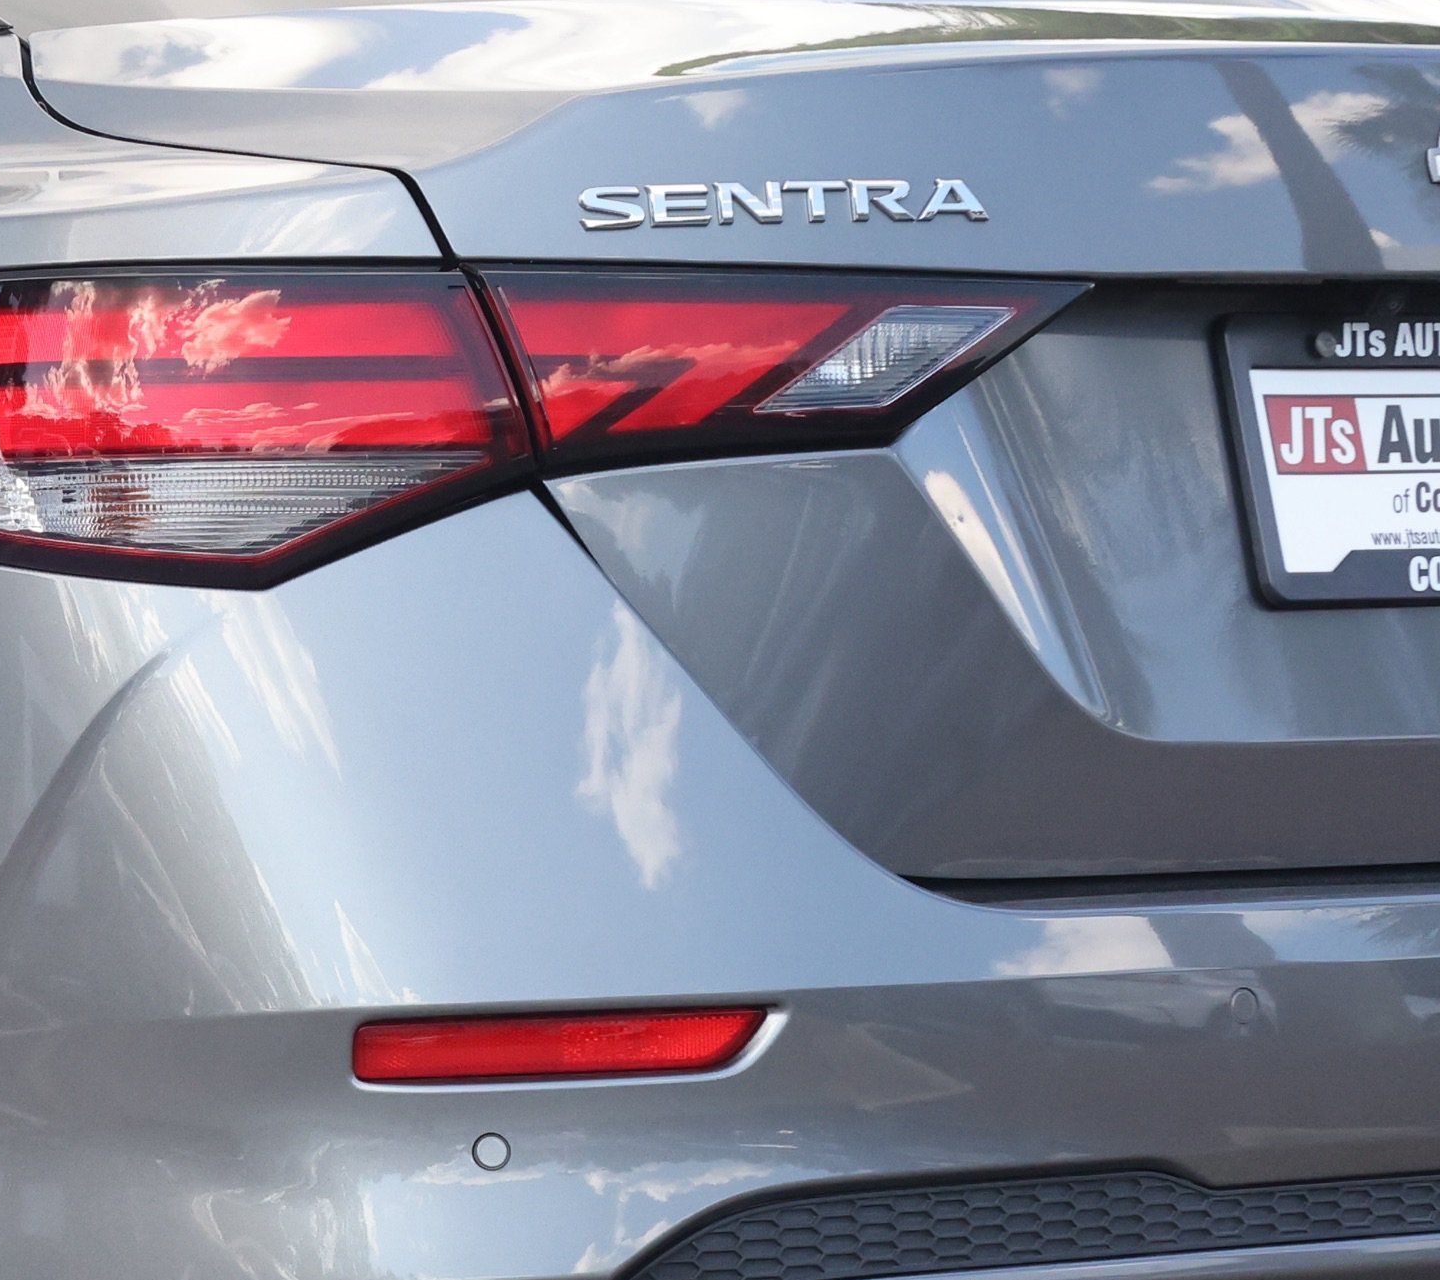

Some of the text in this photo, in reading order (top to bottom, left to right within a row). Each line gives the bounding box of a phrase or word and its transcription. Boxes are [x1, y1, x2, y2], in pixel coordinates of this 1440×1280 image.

[577, 178, 989, 232] SENTRA
[1334, 321, 1386, 359] JTs
[1280, 406, 1356, 466] JTs
[1392, 489, 1412, 515] of
